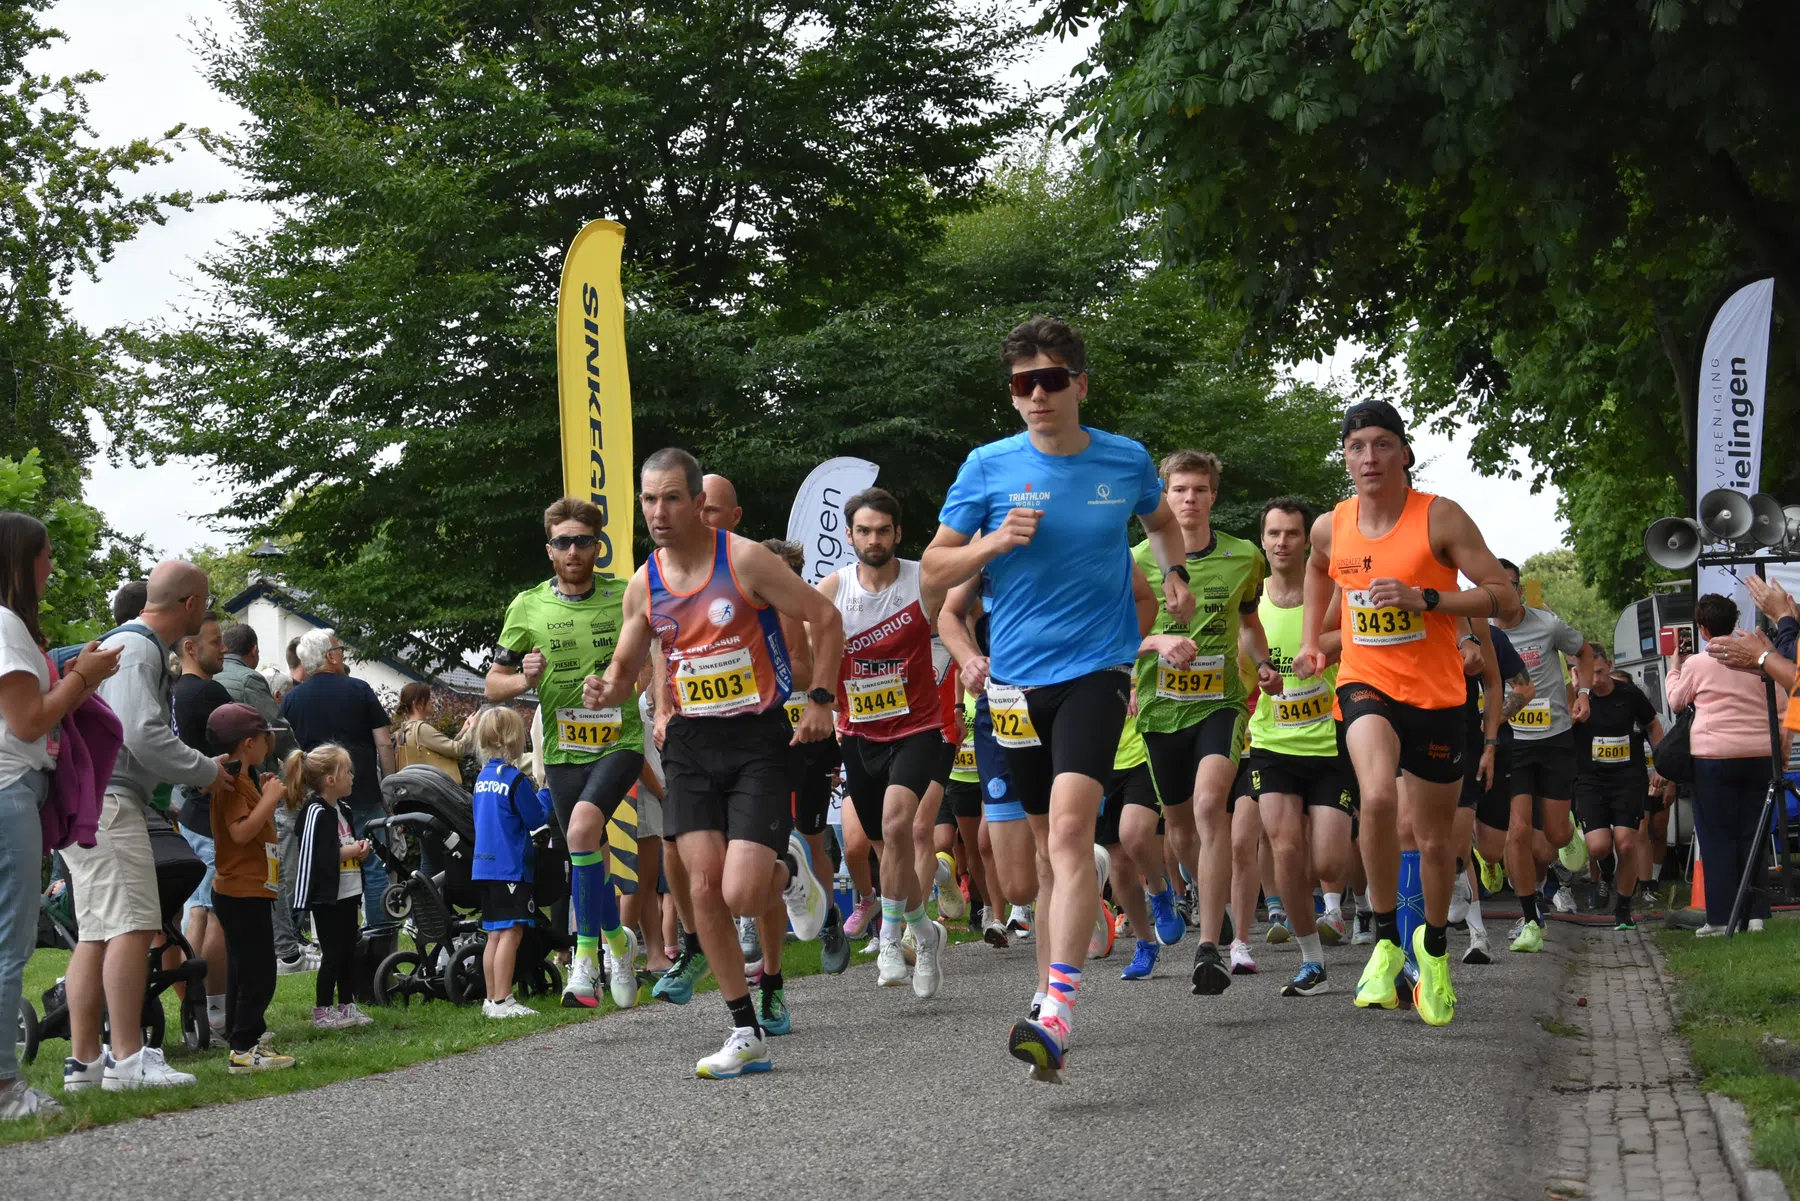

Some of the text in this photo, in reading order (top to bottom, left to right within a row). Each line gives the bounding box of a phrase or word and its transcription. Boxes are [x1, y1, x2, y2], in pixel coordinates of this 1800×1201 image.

[582, 281, 616, 579] SINKEGRO
[1727, 356, 1755, 499] ielingen
[1008, 491, 1050, 502] TRIATHLON
[1015, 500, 1041, 508] WORLD
[1357, 611, 1411, 633] 3433
[847, 612, 913, 655] SODIBRUG
[554, 660, 578, 669] FIESIEK
[698, 657, 741, 671] SINKEGROEP
[854, 662, 904, 675] DELRUE
[687, 673, 744, 701] 2603
[862, 679, 893, 689] SINKEGROEP
[1166, 673, 1213, 692] 2597
[1289, 686, 1321, 697] SINKEGROEP
[854, 690, 897, 713] 3444
[1280, 699, 1321, 720] 3441
[566, 725, 612, 743] 3412
[1597, 747, 1624, 758] 2601
